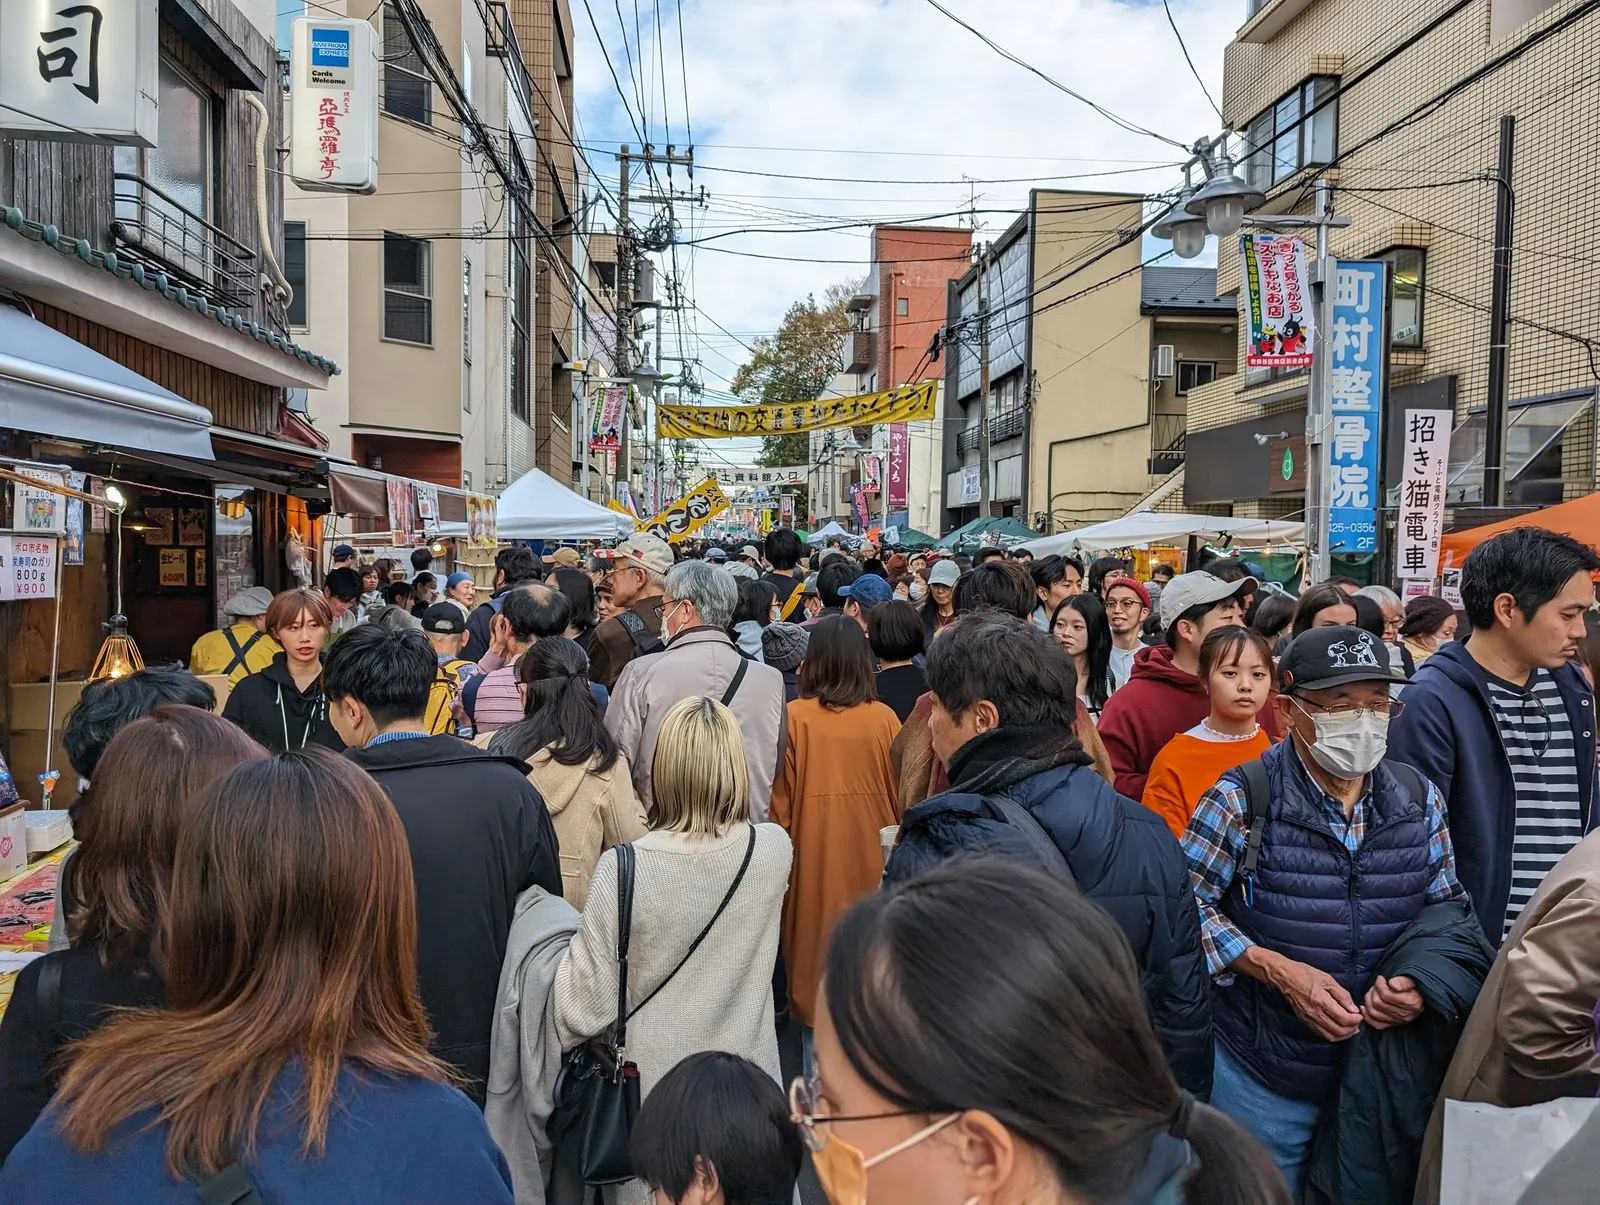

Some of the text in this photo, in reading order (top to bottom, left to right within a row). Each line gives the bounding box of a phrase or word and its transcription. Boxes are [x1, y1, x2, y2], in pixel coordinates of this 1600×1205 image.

[37, 5, 103, 104] 司
[313, 41, 347, 49] AMERICAN
[319, 49, 349, 57] EXPRESS
[1259, 242, 1284, 318] ステキなお店
[1279, 241, 1303, 313] きっと見つかる
[1330, 269, 1375, 508] 町村整骨院
[891, 432, 903, 483] やまぐち
[1402, 414, 1436, 574] 招き猫電車
[15, 542, 49, 553] ボロ市名物
[1357, 537, 1375, 548] 2F
[17, 569, 46, 581] 800g
[17, 583, 46, 594] ¥900
